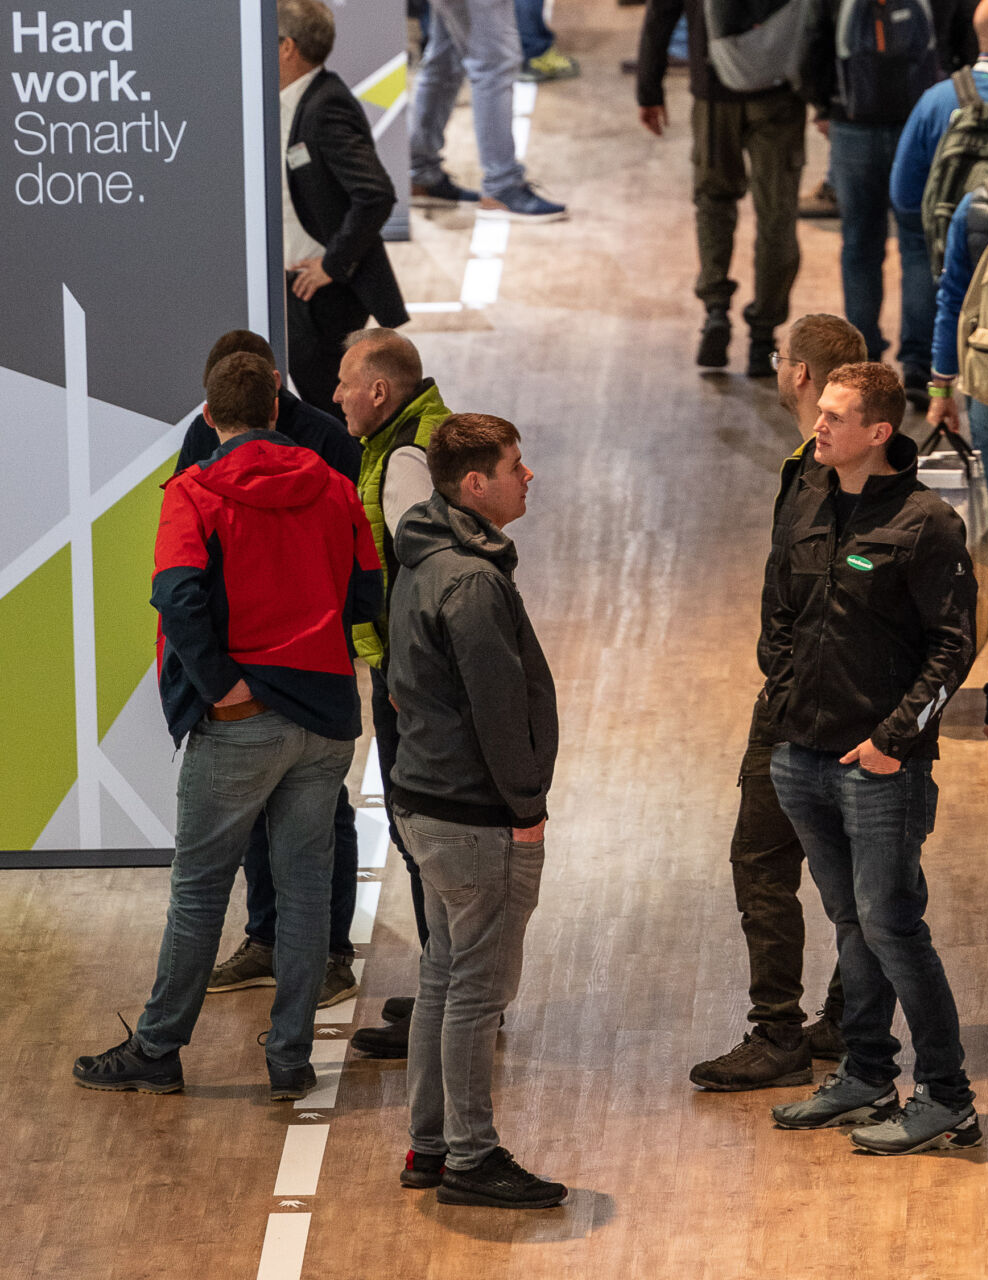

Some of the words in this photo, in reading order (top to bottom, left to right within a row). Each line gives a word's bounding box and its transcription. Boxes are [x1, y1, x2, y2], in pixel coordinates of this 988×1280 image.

[12, 9, 133, 53] Hard
[11, 60, 150, 103] work.
[14, 110, 187, 163] Smartly
[15, 162, 145, 205] done.
